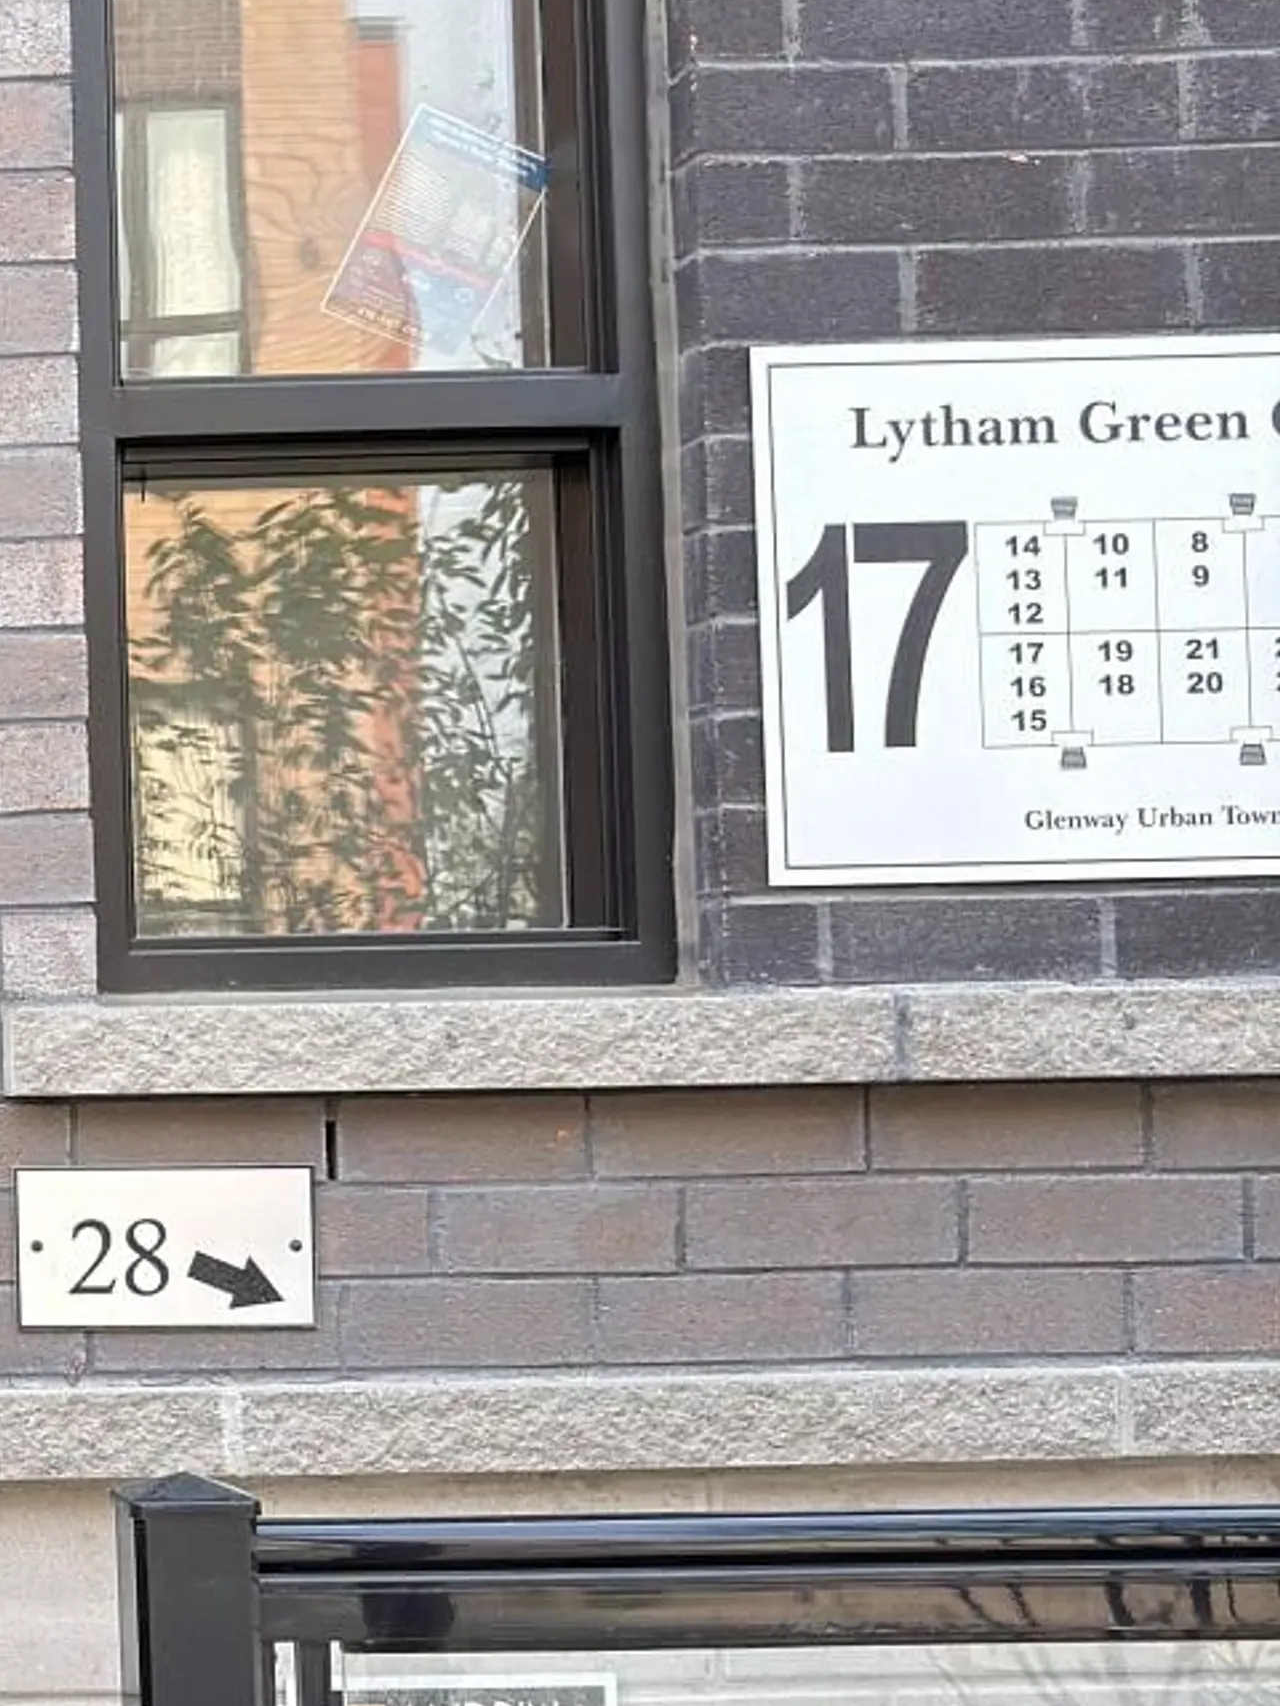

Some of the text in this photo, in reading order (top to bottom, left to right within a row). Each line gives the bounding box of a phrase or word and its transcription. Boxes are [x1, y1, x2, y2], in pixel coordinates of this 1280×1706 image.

[851, 403, 1058, 463] Lytham
[1079, 400, 1251, 445] Green
[1004, 535, 1042, 557] 14
[1093, 533, 1130, 555] 10
[1191, 531, 1209, 553] 8
[1006, 569, 1042, 591] 13
[1094, 567, 1128, 588] 11
[1192, 565, 1210, 587] 9
[1008, 602, 1044, 624] 12
[785, 520, 970, 753] 17
[1009, 642, 1044, 664] 17
[1098, 640, 1133, 662] 19
[1186, 638, 1219, 660] 21
[1010, 676, 1047, 698] 16
[1099, 674, 1135, 696] 18
[1187, 672, 1223, 694] 20
[1011, 709, 1048, 731] 15
[1024, 809, 1128, 835] Glenway
[1137, 805, 1213, 828] Urban
[69, 1218, 170, 1296] 28
